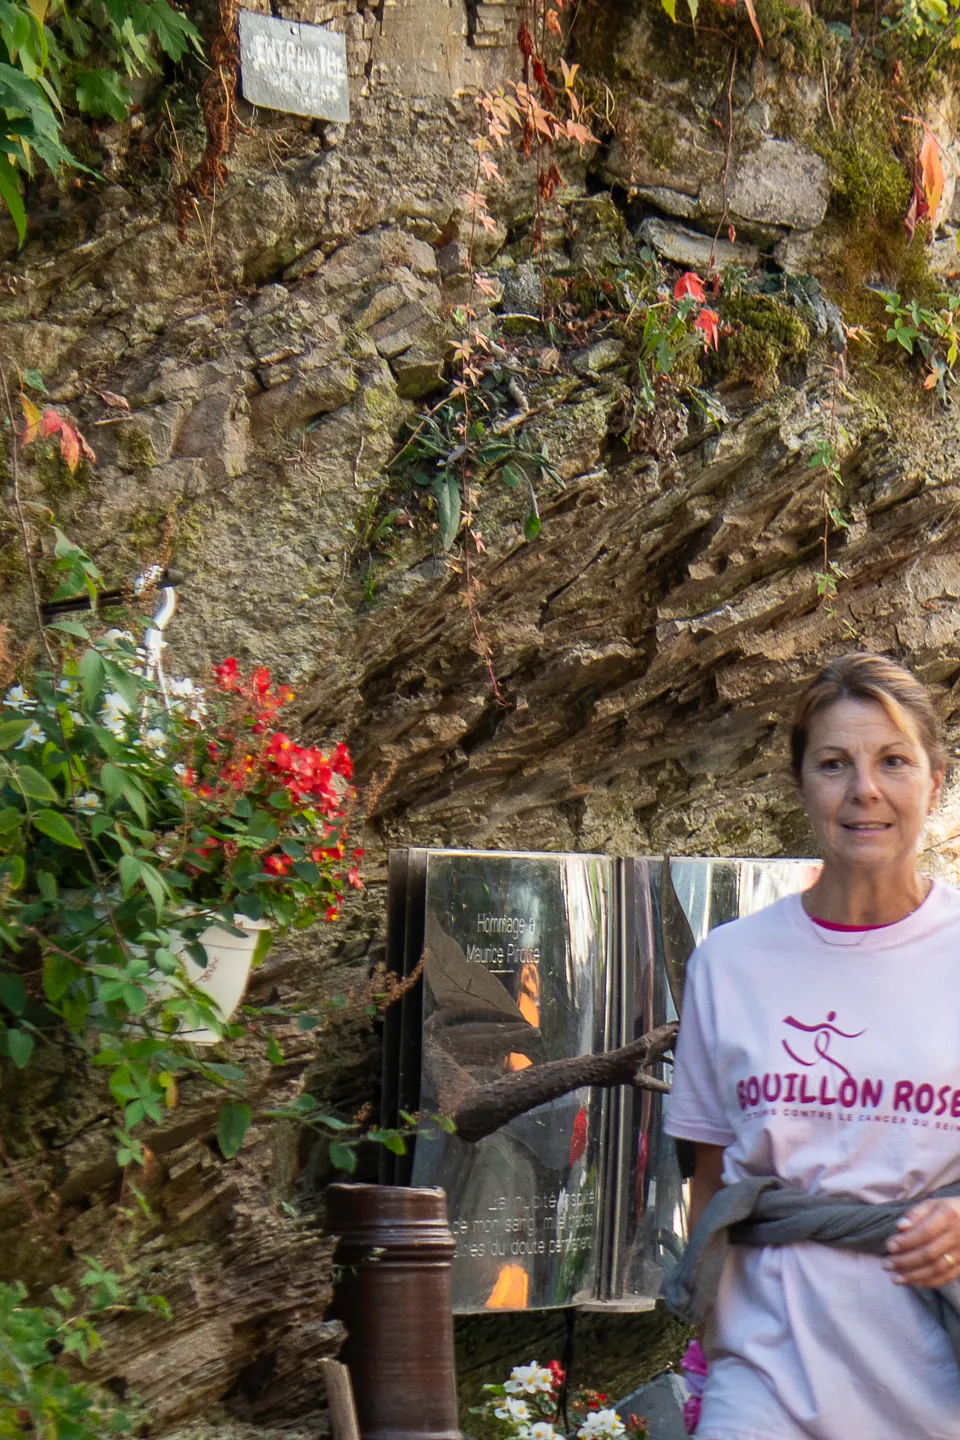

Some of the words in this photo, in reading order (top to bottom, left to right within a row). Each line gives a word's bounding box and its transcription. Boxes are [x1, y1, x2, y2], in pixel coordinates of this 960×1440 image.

[477, 912, 526, 939] Hommage
[466, 943, 504, 963] Maurice
[783, 1108, 833, 1120] CONTRE
[857, 1114, 907, 1125] CANCER
[911, 1118, 930, 1127] DU
[490, 1238, 506, 1256] du
[511, 1237, 545, 1256] doute
